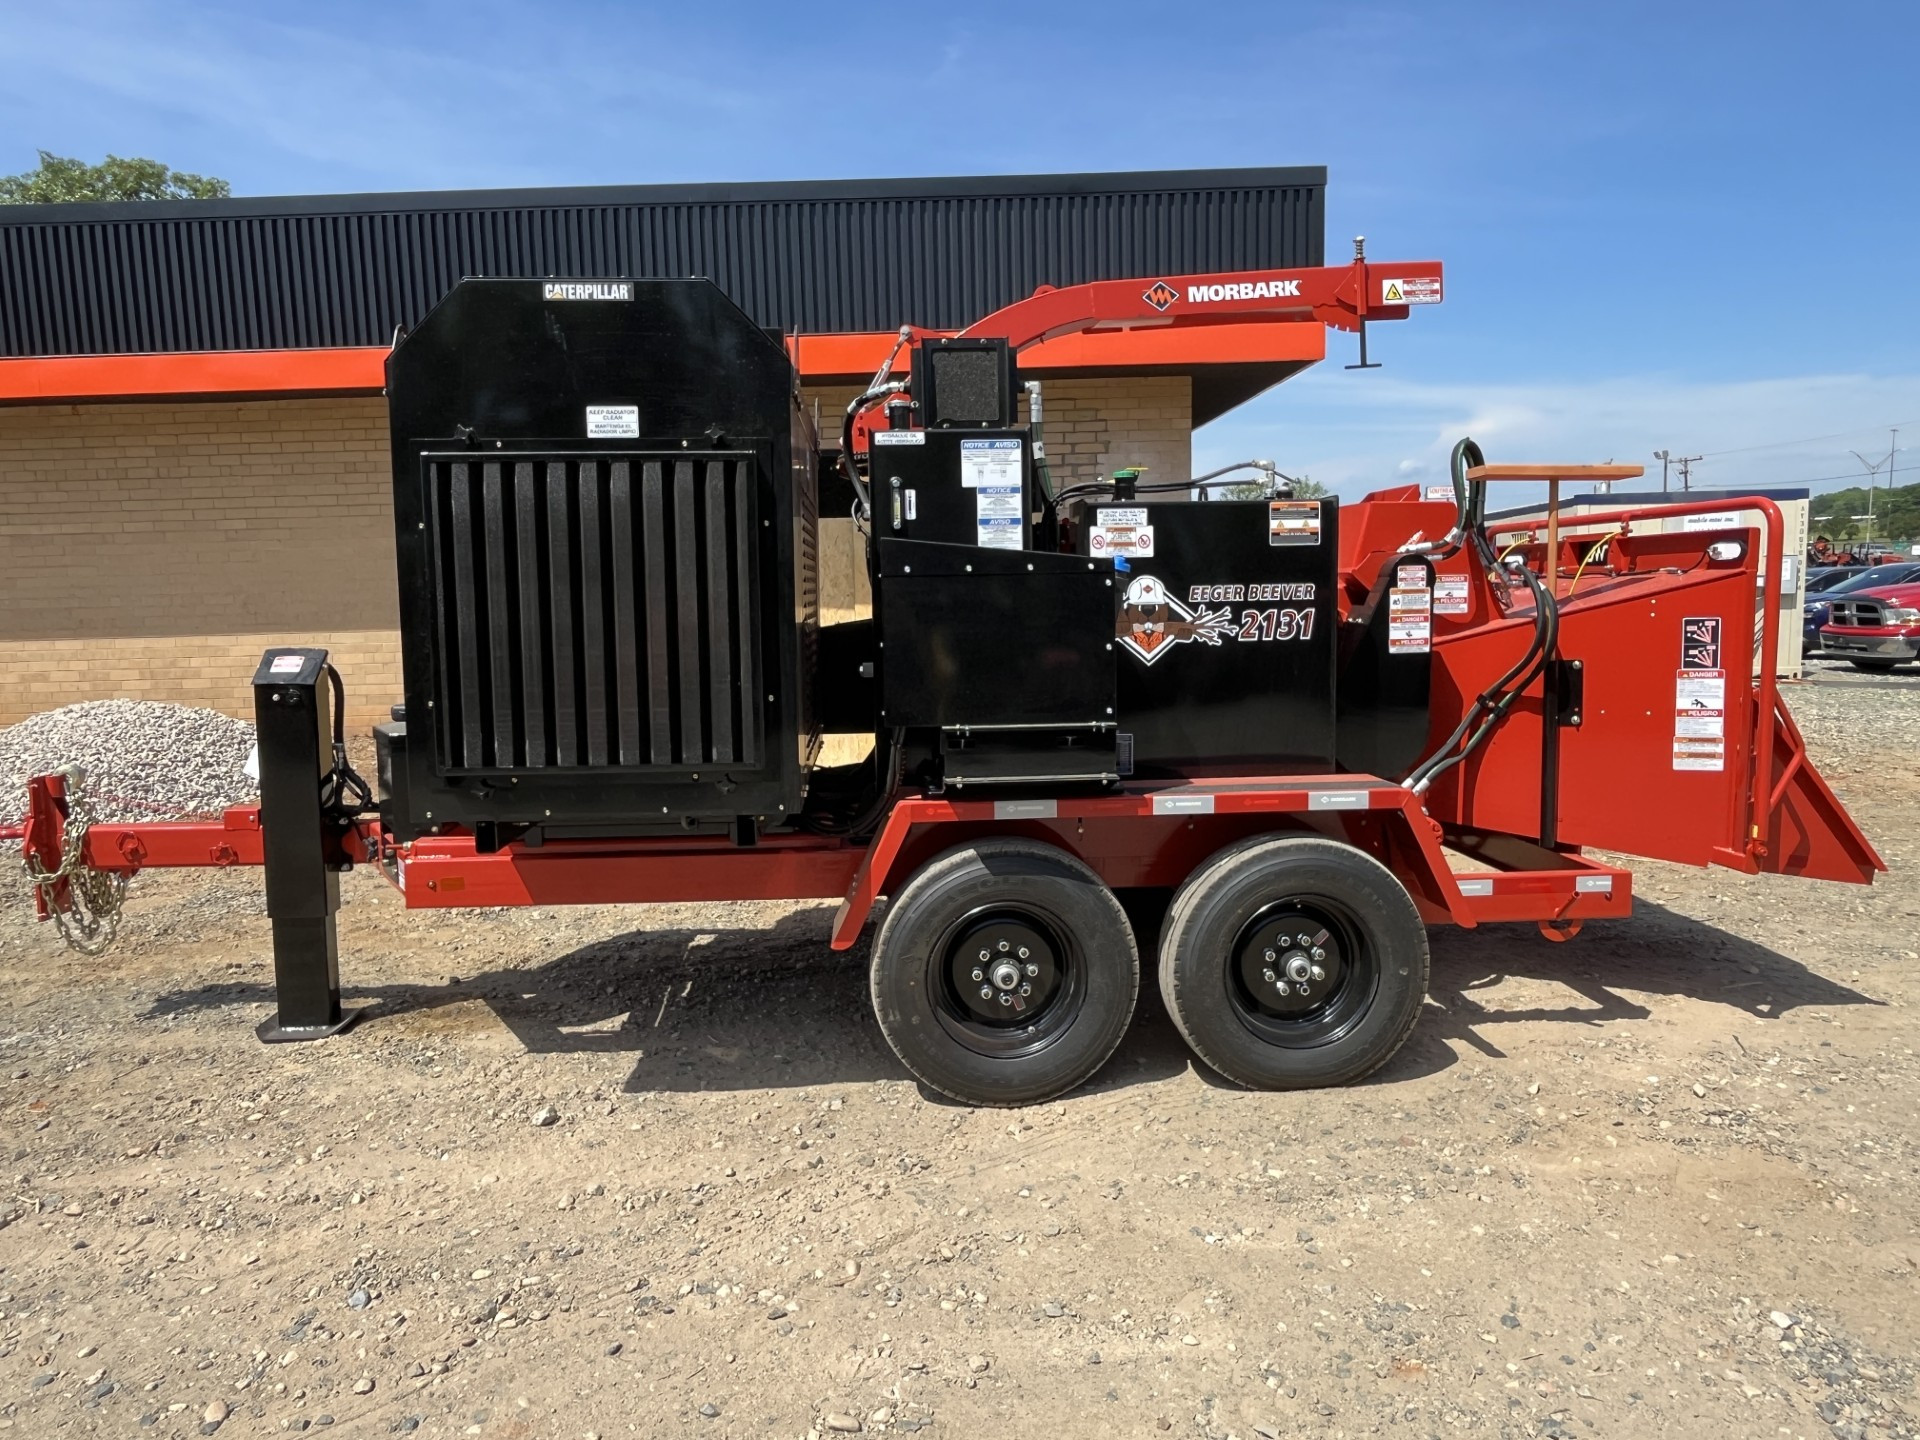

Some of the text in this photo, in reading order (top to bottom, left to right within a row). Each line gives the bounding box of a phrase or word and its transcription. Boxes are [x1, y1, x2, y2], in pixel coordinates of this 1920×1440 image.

[545, 284, 628, 299] CATERPILLAR
[1188, 280, 1300, 303] MORBARK
[994, 441, 1018, 449] AVISO
[1189, 583, 1316, 603] EEGER BEEVER
[1238, 608, 1316, 642] 2131
[1688, 709, 1719, 717] PELIGRO
